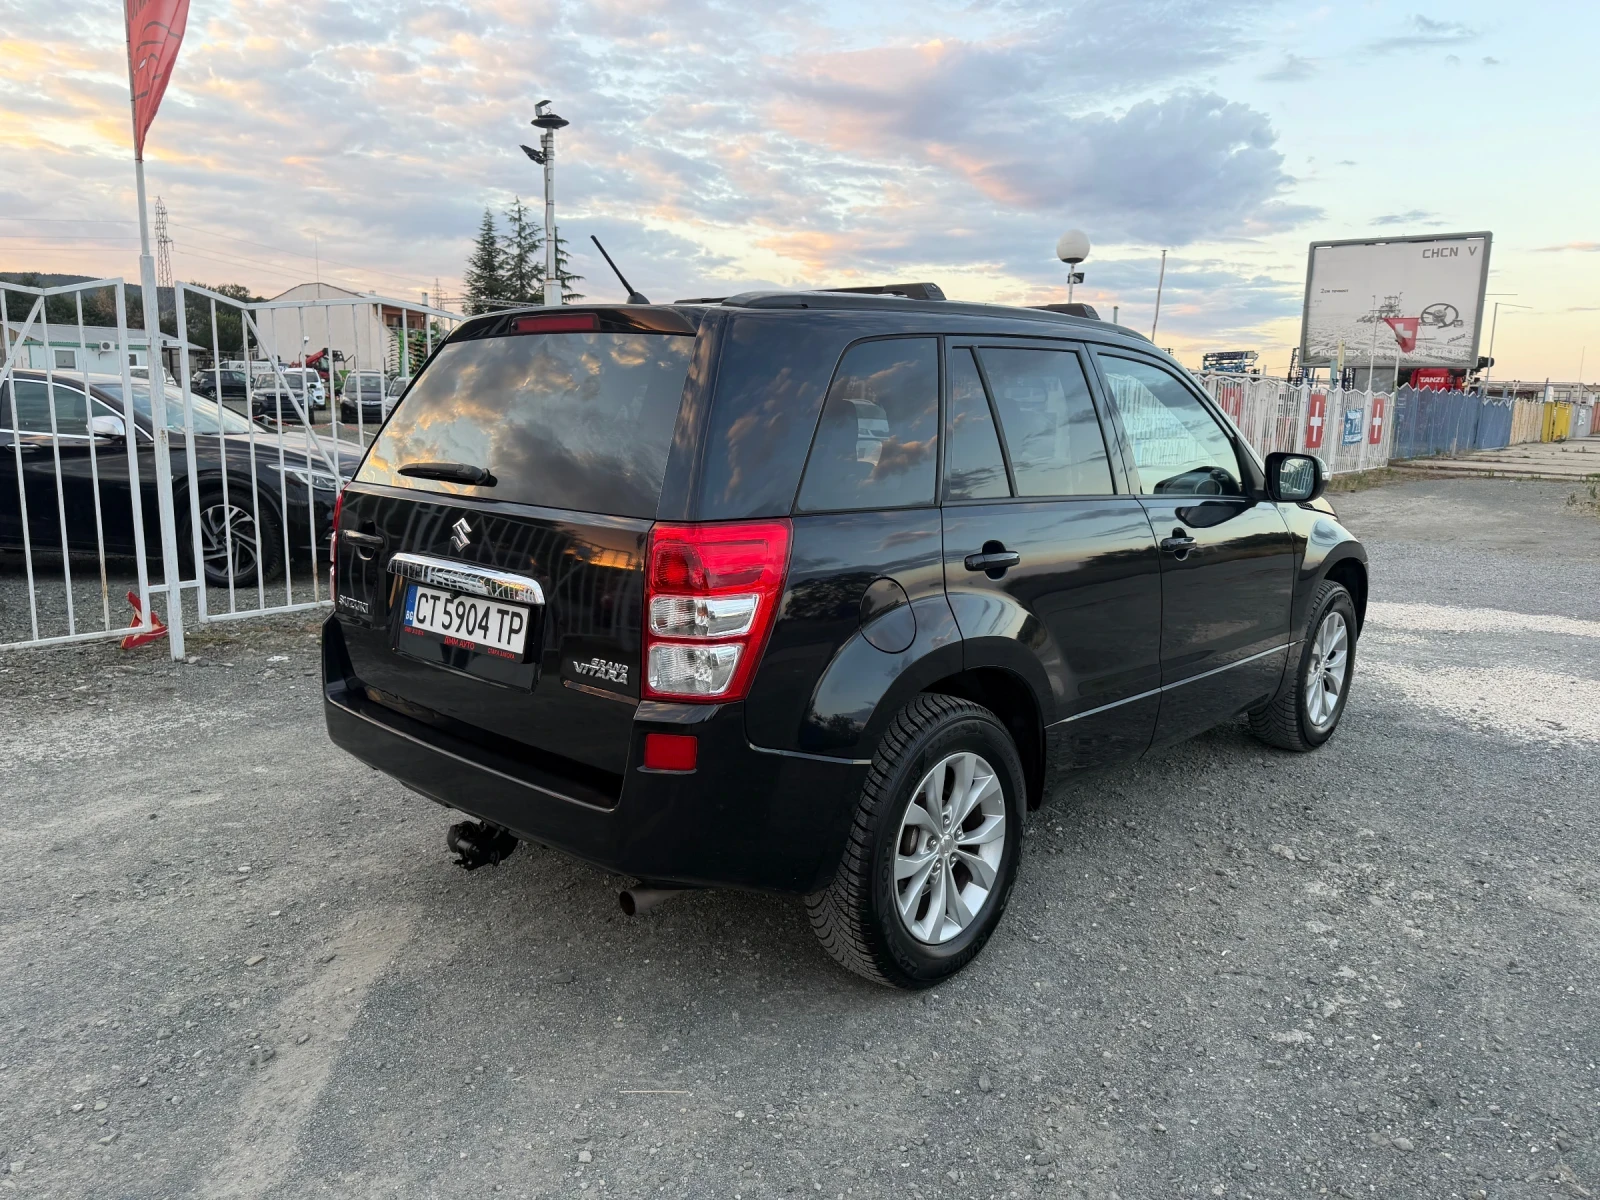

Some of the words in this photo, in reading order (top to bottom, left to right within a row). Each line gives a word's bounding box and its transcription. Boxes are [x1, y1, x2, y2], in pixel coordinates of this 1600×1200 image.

[1319, 349, 1362, 357] INOEX
[338, 594, 369, 614] SUZUKI
[405, 610, 414, 620] BG
[441, 597, 491, 640] 5904
[496, 608, 524, 645] TP
[572, 661, 628, 685] VITARA
[590, 657, 629, 673] GRAND
